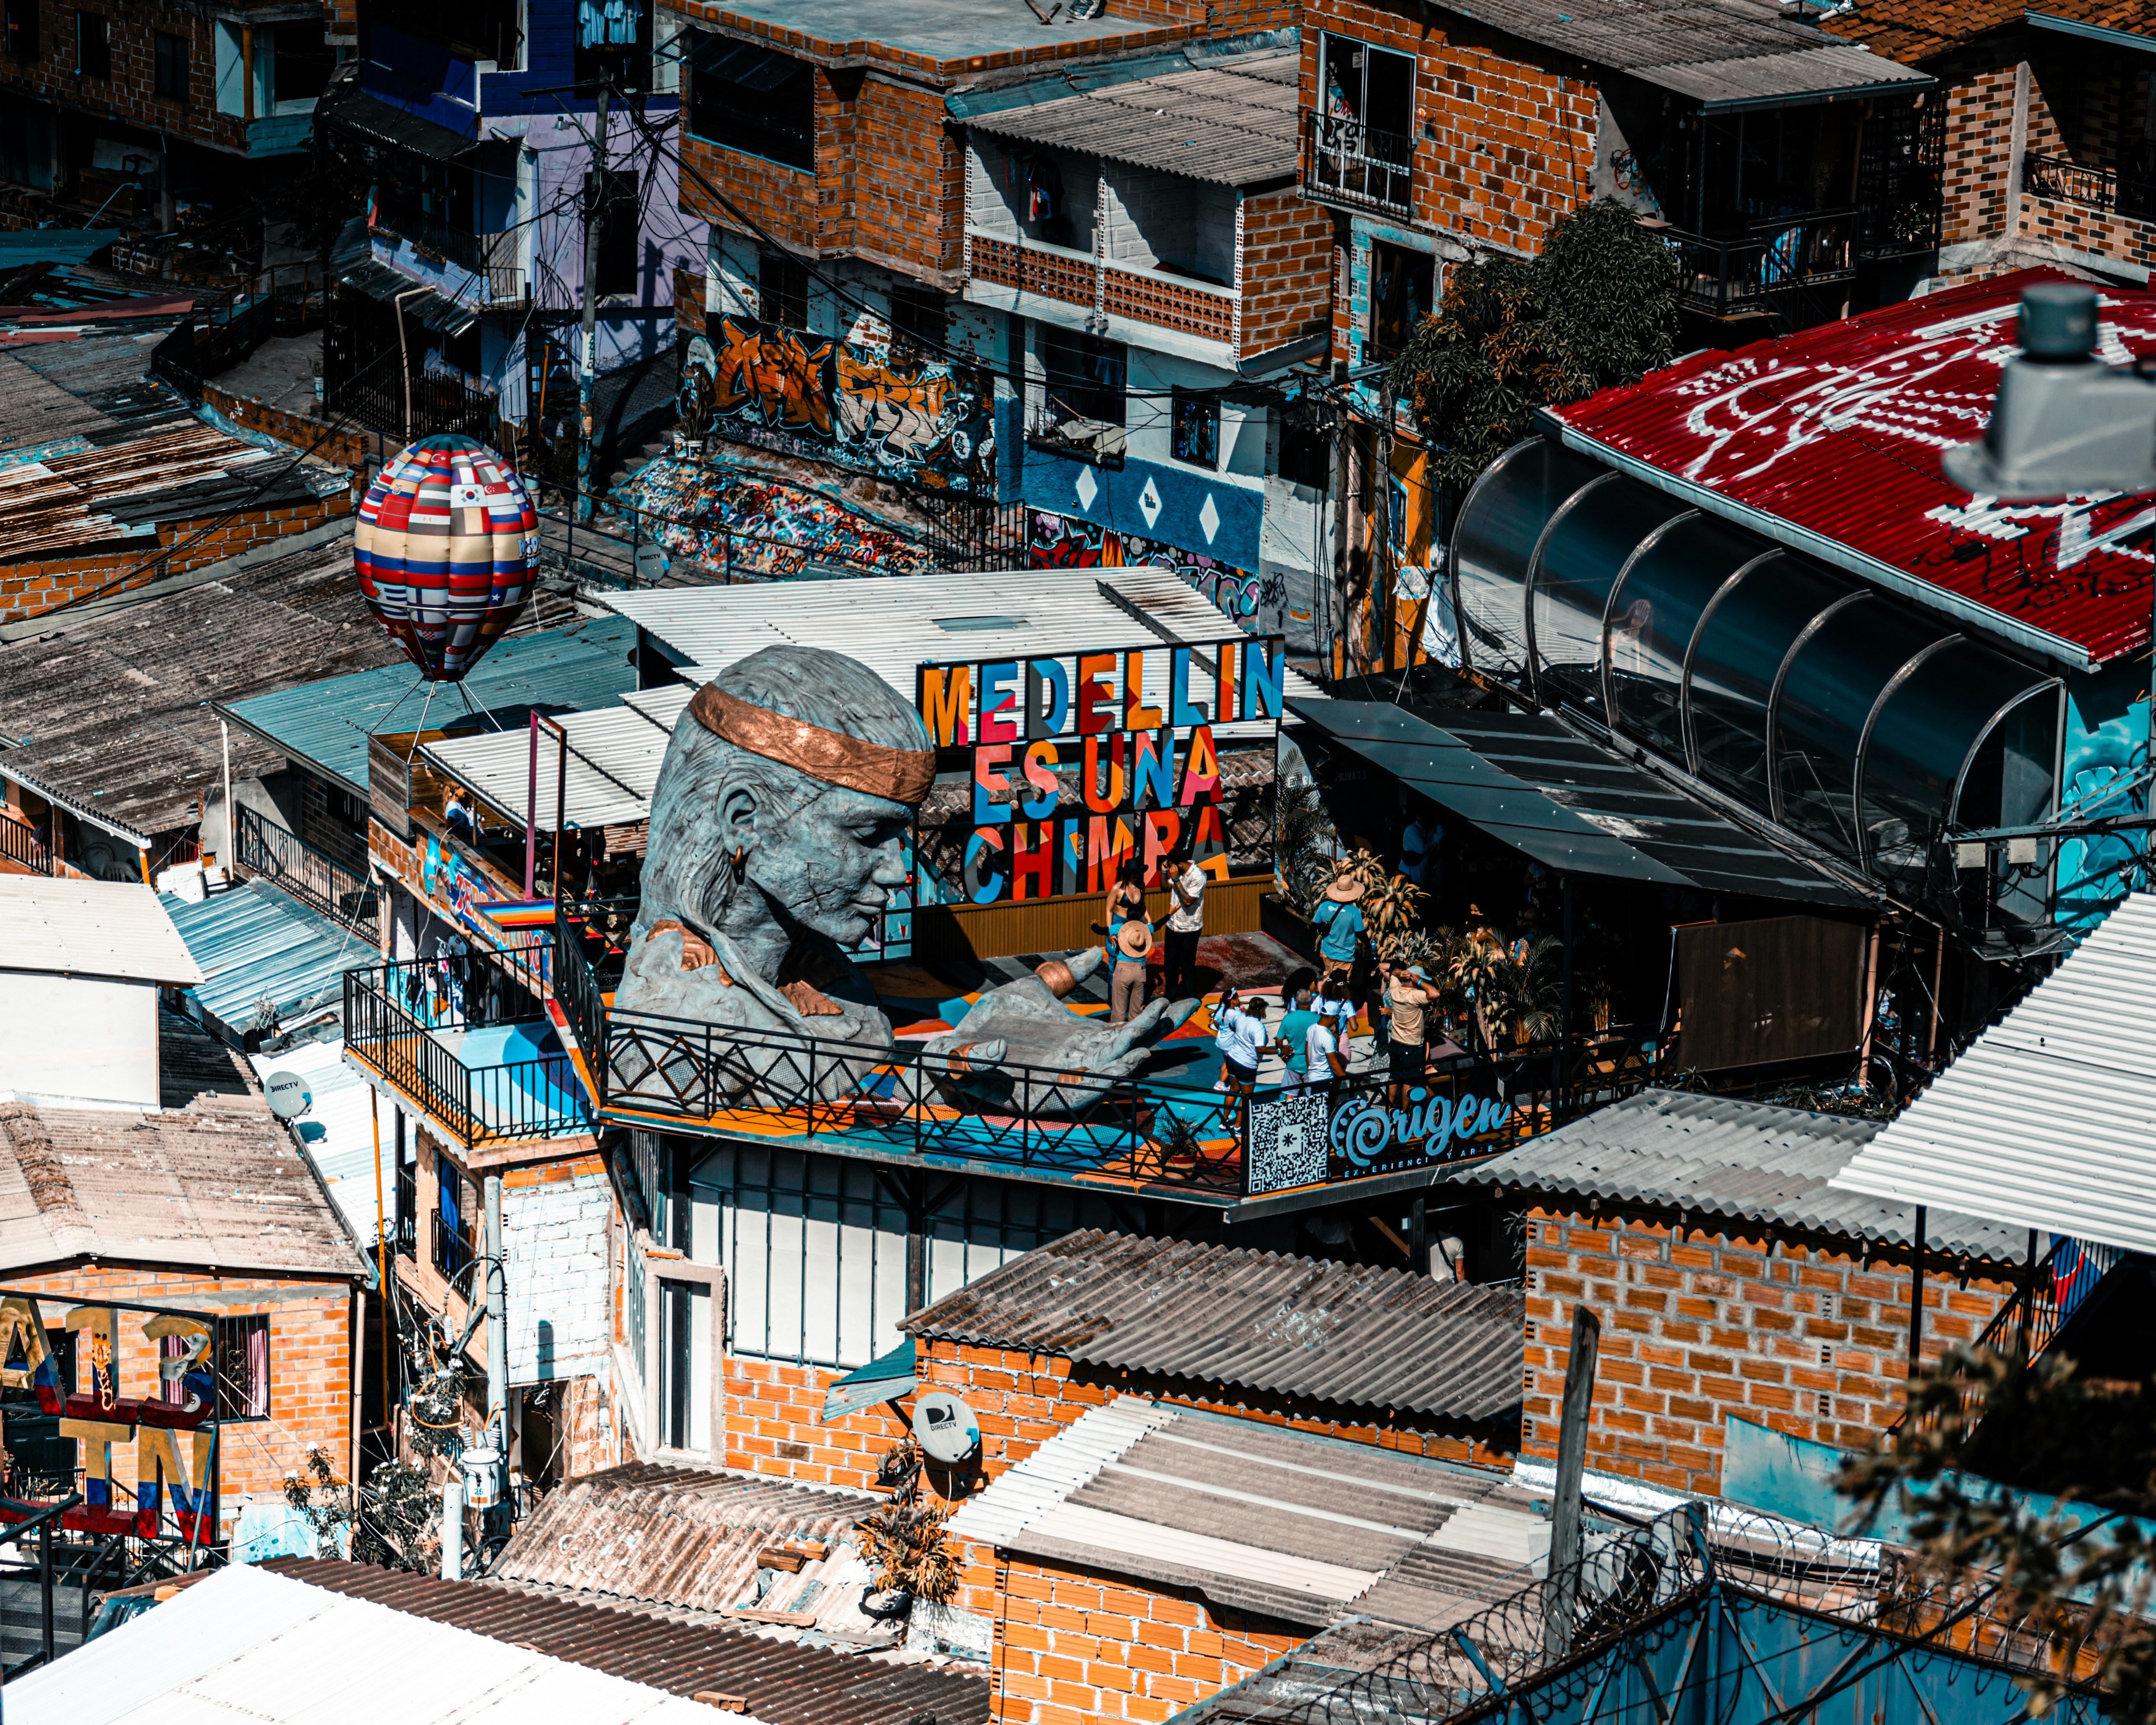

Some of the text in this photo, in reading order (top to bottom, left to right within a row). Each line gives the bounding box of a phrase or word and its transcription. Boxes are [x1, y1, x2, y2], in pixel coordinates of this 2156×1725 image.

[922, 636, 1285, 747] MEDELLIN
[972, 725, 1224, 825] ES UNA
[270, 1080, 298, 1093] DIRECTV
[1331, 1087, 1511, 1167] Origen
[1446, 1151, 1452, 1159] Y
[930, 1421, 957, 1431] DIRECTV
